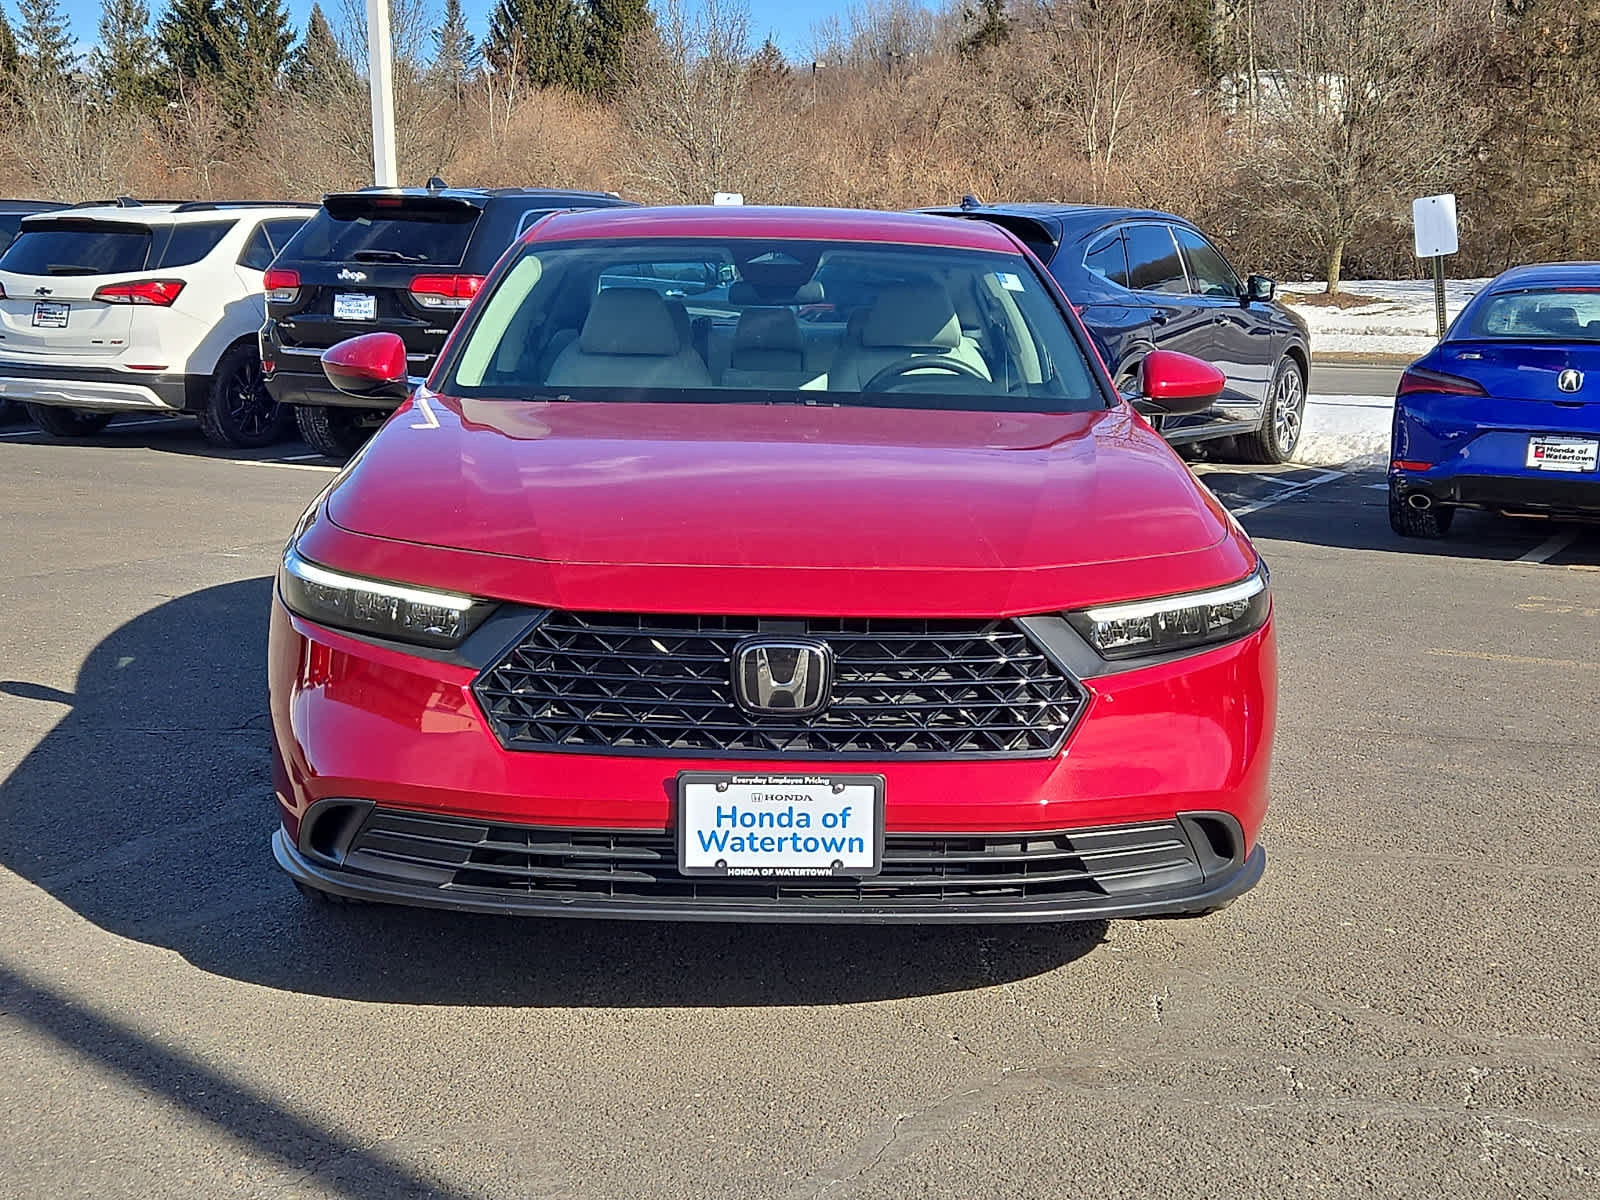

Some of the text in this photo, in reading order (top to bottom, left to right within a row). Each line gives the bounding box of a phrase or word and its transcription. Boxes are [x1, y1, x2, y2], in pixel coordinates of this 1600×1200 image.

[337, 269, 367, 283] Jeep
[1546, 446, 1575, 454] Honda
[1545, 453, 1594, 462] Watertown
[732, 776, 830, 786] Everyday Employee Pricing
[764, 794, 814, 802] HONDA
[716, 805, 852, 828] Honda of
[697, 830, 864, 853] Watertown
[727, 868, 833, 876] HONDA OF WATERTOWN
